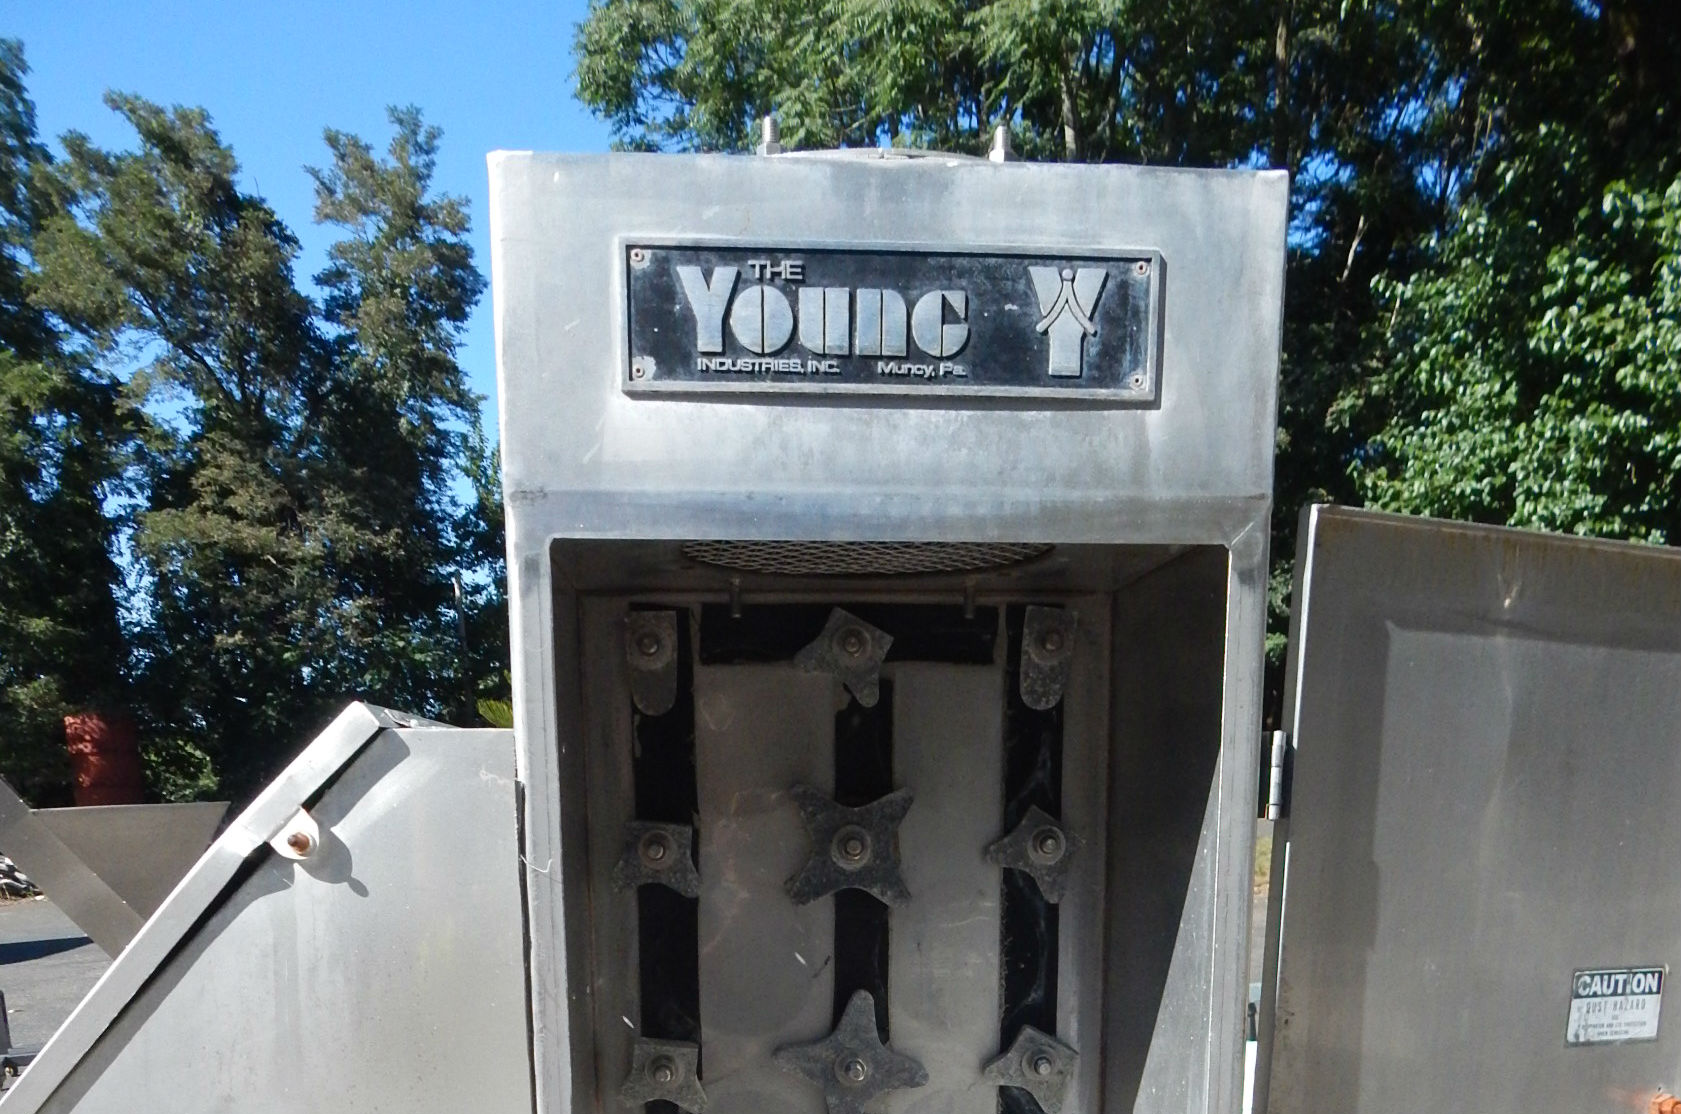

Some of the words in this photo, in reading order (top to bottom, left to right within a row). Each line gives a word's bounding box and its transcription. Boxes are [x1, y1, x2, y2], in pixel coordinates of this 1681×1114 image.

[748, 260, 803, 279] THE
[697, 358, 804, 373] INDUSTRIES,
[878, 361, 935, 377] Muncy,
[1577, 972, 1659, 996] CAUTION
[1613, 998, 1646, 1011] HAZARD
